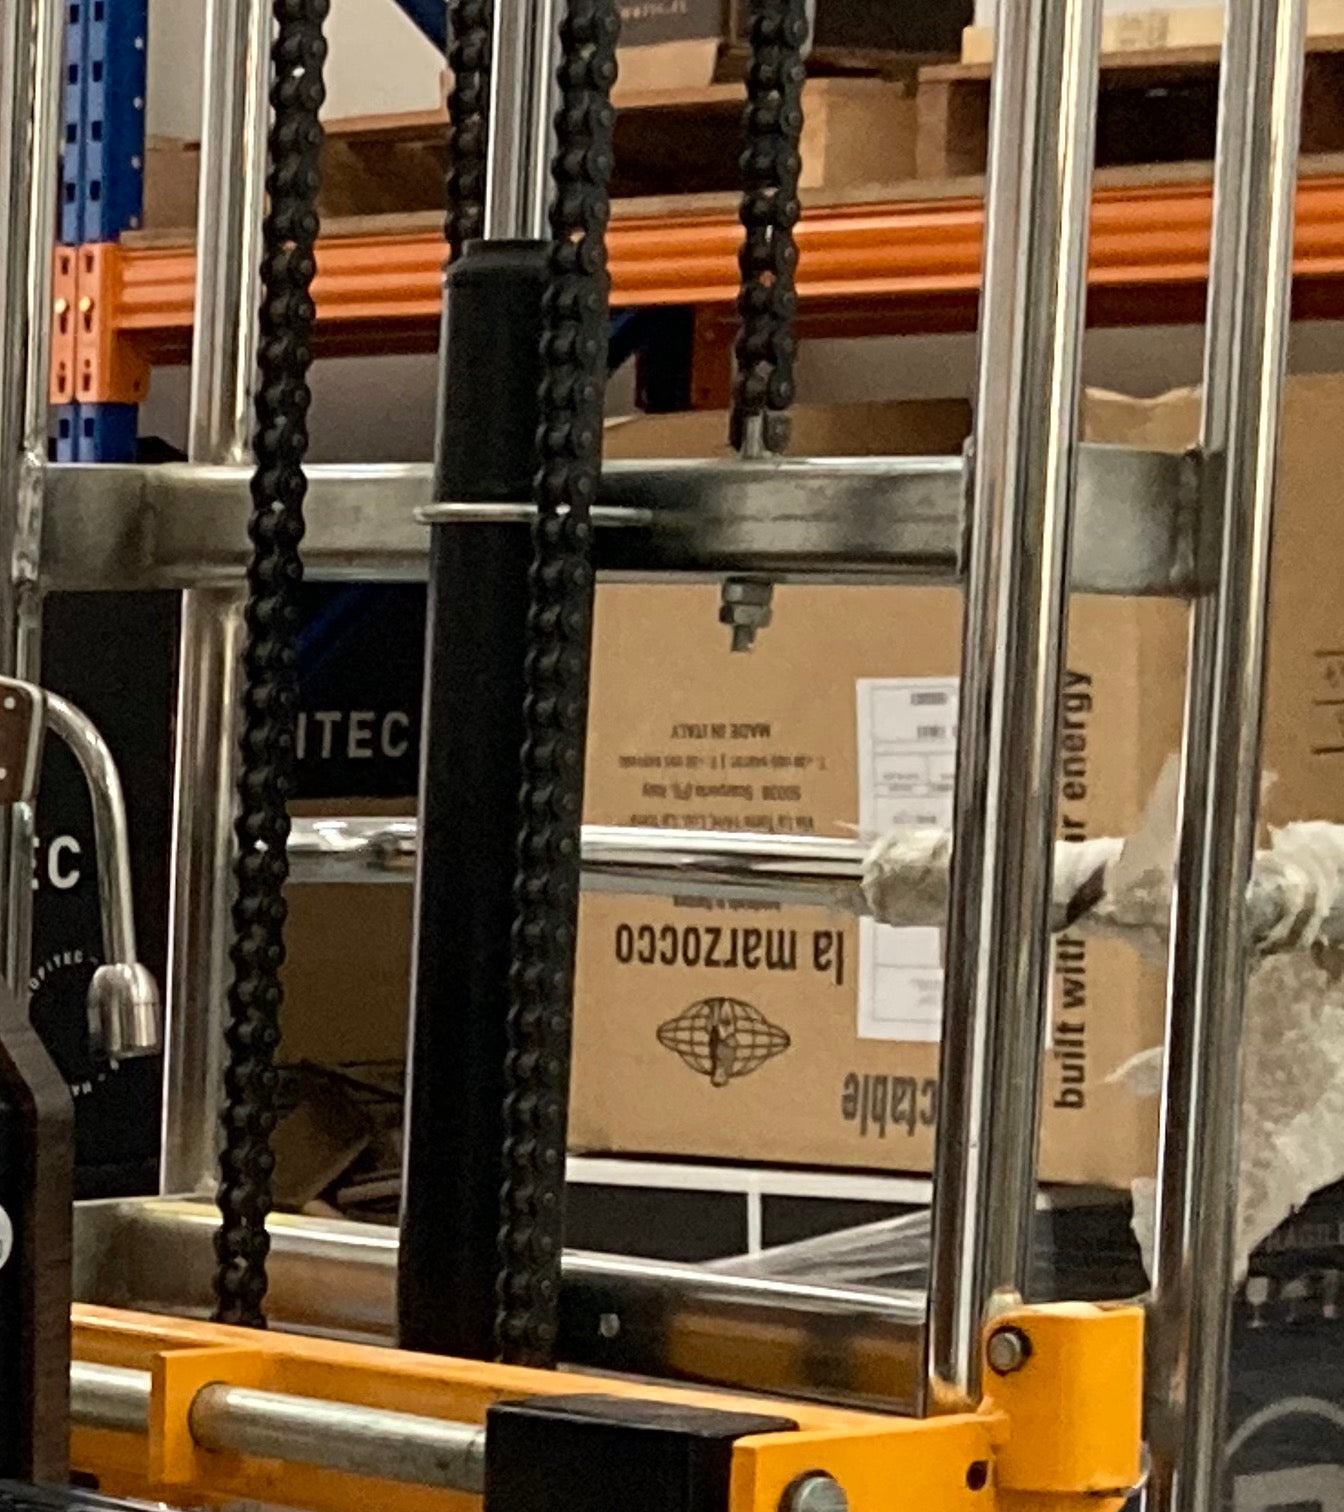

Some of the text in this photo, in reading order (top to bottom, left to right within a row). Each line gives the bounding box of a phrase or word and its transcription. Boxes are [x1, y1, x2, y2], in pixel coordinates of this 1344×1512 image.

[1062, 668, 1093, 801] energy
[615, 923, 845, 986] la marzocco
[1053, 1021, 1086, 1109] built
